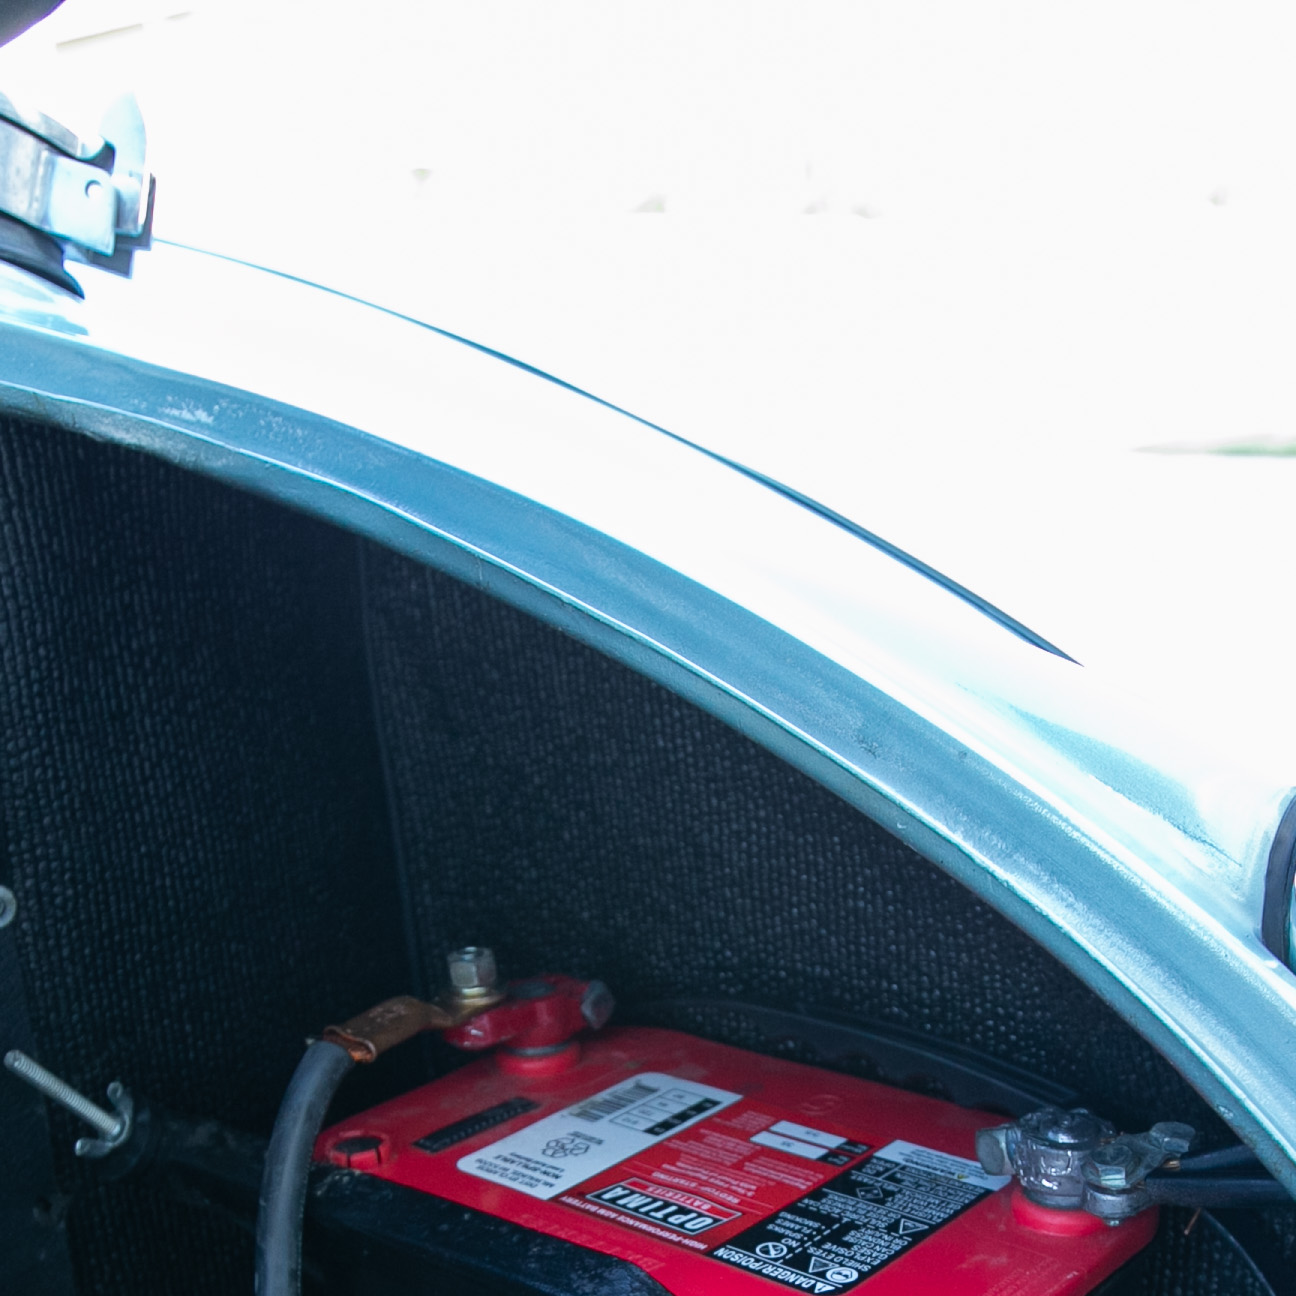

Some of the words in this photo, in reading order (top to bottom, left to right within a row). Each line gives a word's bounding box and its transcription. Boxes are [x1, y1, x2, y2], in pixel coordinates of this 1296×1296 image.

[643, 1184, 715, 1211] BATTERIES
[596, 1185, 718, 1232] OPTIMA
[771, 1217, 814, 1234] FLAMES
[775, 1210, 823, 1228] SMOKING
[763, 1222, 806, 1239] SPARKS
[778, 1236, 802, 1247] NO
[818, 1241, 883, 1266] EXPLOSIVE
[847, 1243, 891, 1260] GASES
[709, 1246, 819, 1288] DANGER/POISON
[830, 1254, 874, 1272] SHIELD
